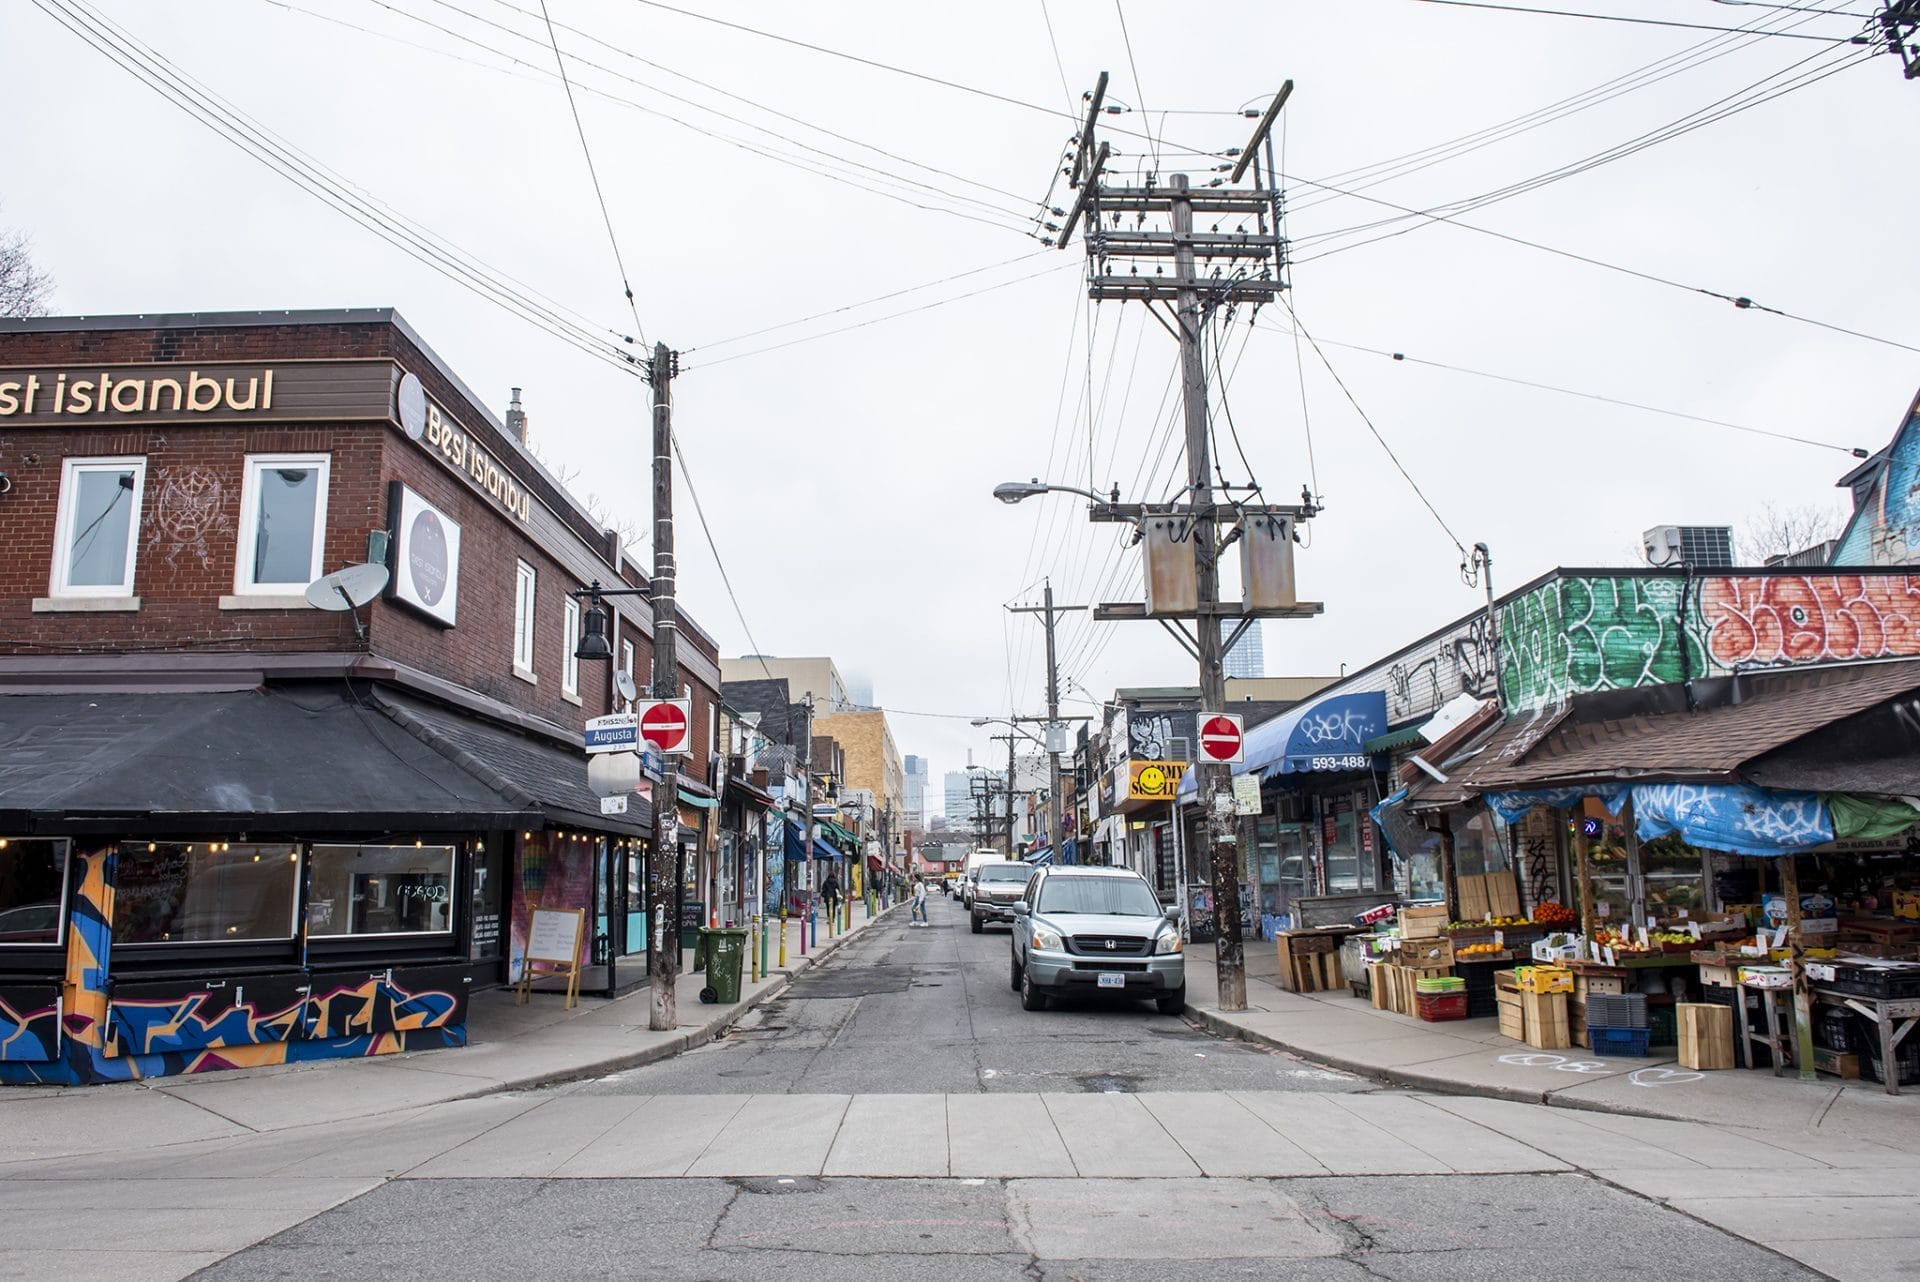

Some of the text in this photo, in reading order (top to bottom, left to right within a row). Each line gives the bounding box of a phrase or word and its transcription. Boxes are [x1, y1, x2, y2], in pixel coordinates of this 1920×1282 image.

[54, 370, 273, 414] istanbul
[428, 403, 530, 524] Best istanbul
[594, 729, 632, 743] Augusta
[1312, 756, 1372, 769] 593-4887
